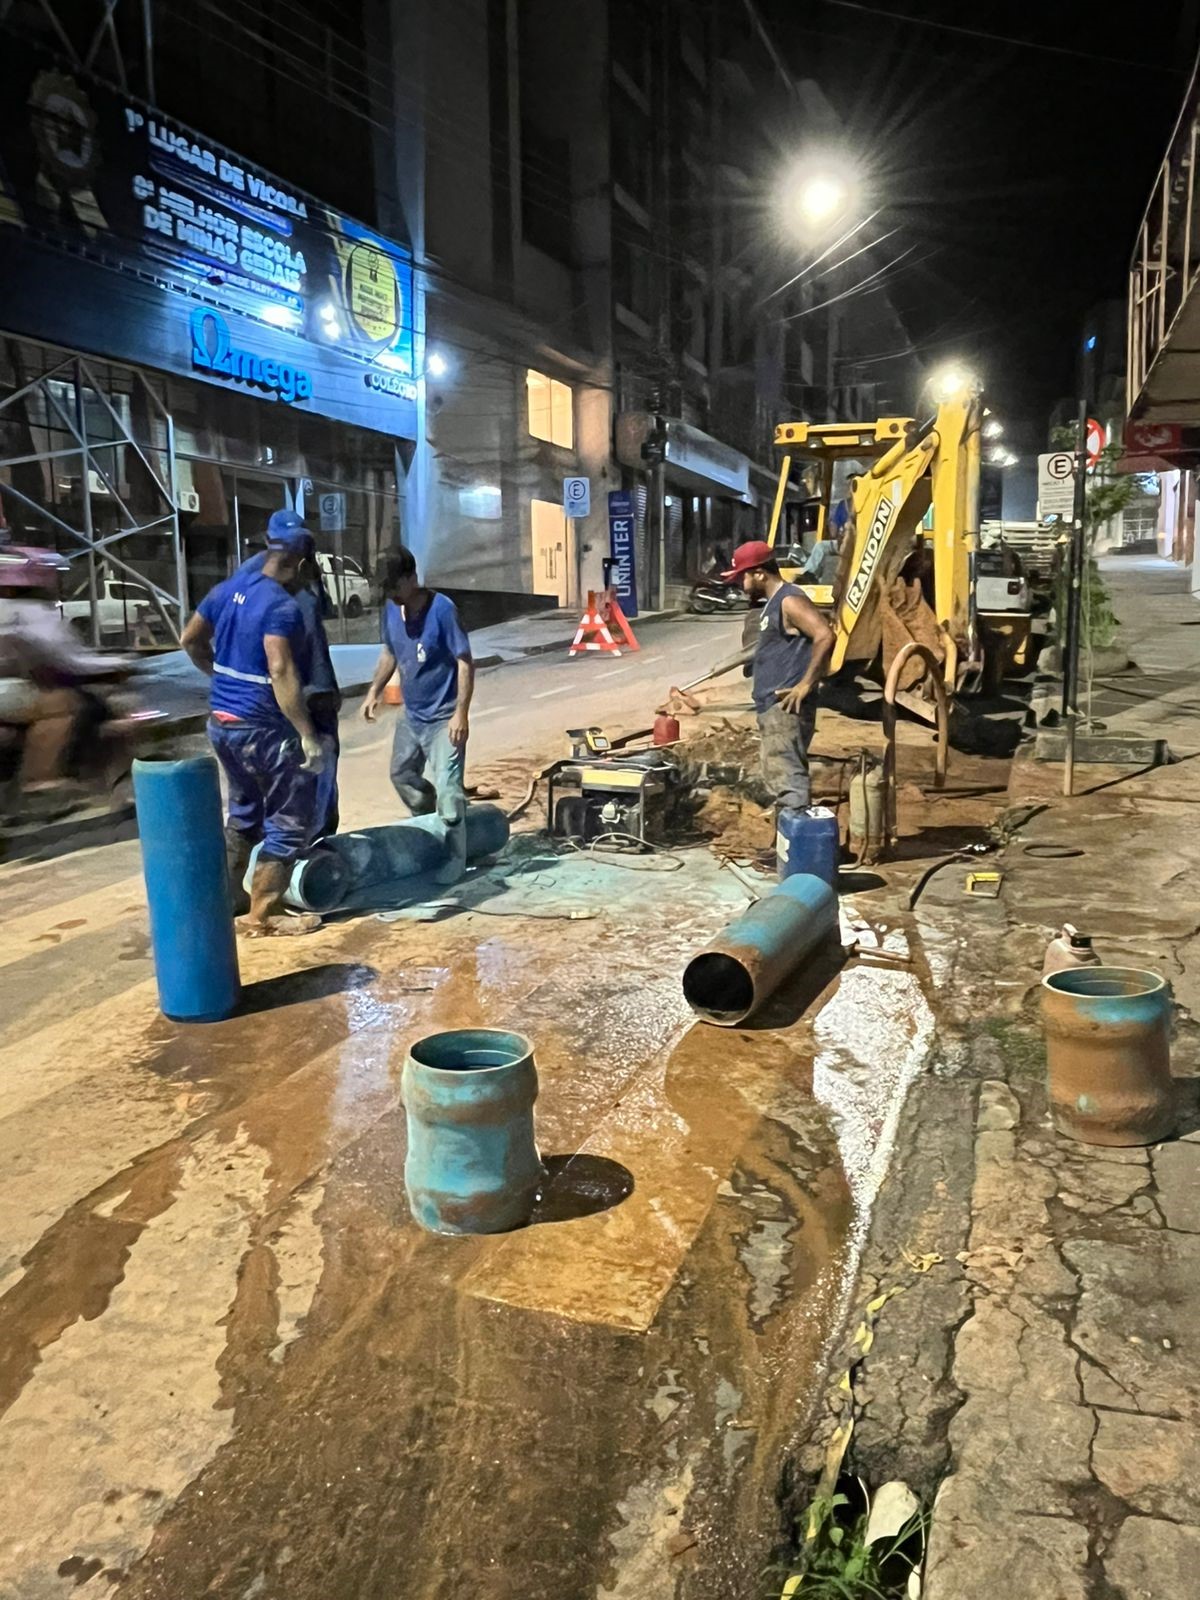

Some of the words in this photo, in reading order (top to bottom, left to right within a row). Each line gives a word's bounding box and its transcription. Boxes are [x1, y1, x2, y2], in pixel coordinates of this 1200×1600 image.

[149, 121, 217, 176] LUGAR
[219, 159, 245, 191] DE
[143, 204, 173, 236] DE
[176, 218, 238, 265] MINAS
[241, 225, 307, 275] ESCOLA
[1055, 459, 1067, 474] E
[613, 520, 632, 597] UNINTER
[850, 502, 893, 605] RANDON
